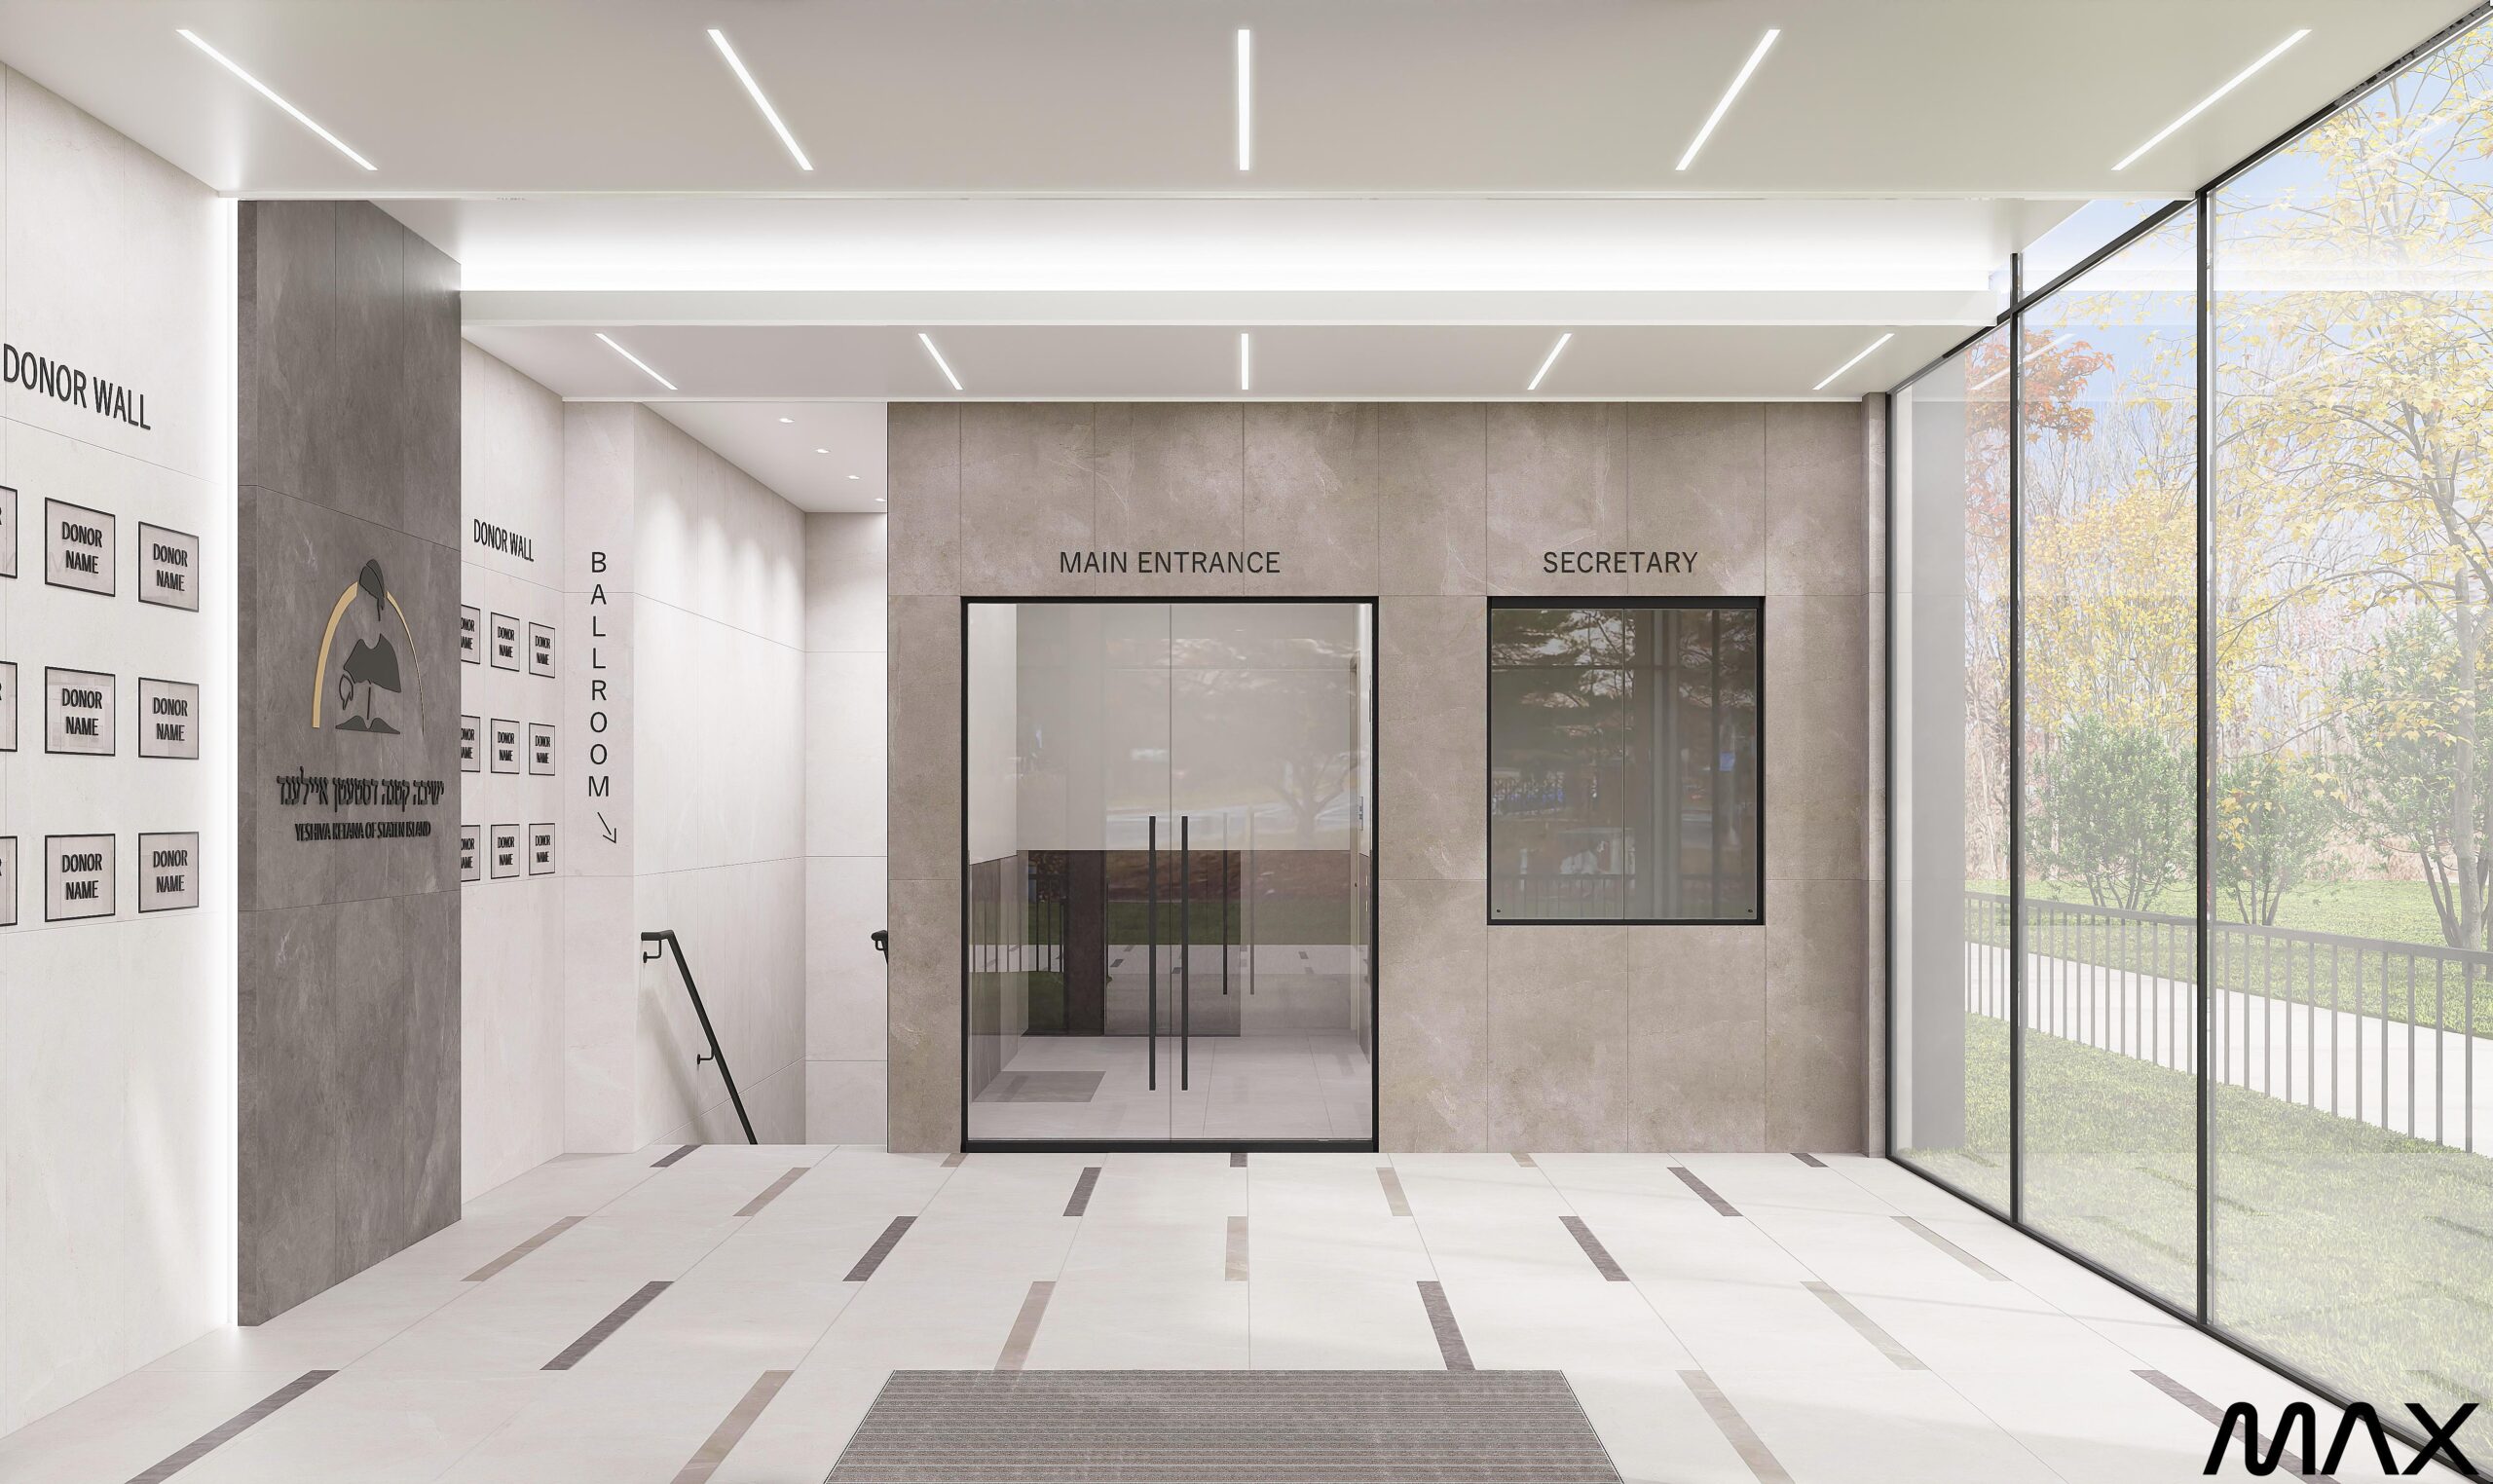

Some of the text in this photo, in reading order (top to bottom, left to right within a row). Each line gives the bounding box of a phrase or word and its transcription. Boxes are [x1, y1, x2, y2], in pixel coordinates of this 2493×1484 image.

[4, 344, 150, 430] DONOR WALL
[62, 522, 102, 548] DONOR
[474, 519, 534, 562] DONOR WALL
[66, 550, 98, 574] NAME
[153, 543, 187, 567] DONOR
[1060, 552, 1280, 573] MAIN ENTRANCE
[1544, 552, 1697, 573] SECRETARY
[157, 570, 185, 591] NAME
[461, 617, 474, 632] ONOR
[589, 552, 609, 797] BALLROOM
[62, 688, 102, 709] DONOR
[153, 697, 187, 717] DONOR
[66, 717, 98, 736] NAME
[157, 723, 185, 741] NAME
[461, 728, 474, 741] ONOR
[382, 779, 410, 812] קטנה
[413, 780, 444, 805] ישיבה
[295, 821, 430, 841] YESHIVA KETANA OF STATEN ISLAND
[461, 838, 474, 850] ONOR
[62, 853, 102, 872] DONOR
[153, 850, 188, 868] DONOR
[65, 880, 98, 900] NAME
[157, 874, 185, 893] NAME
